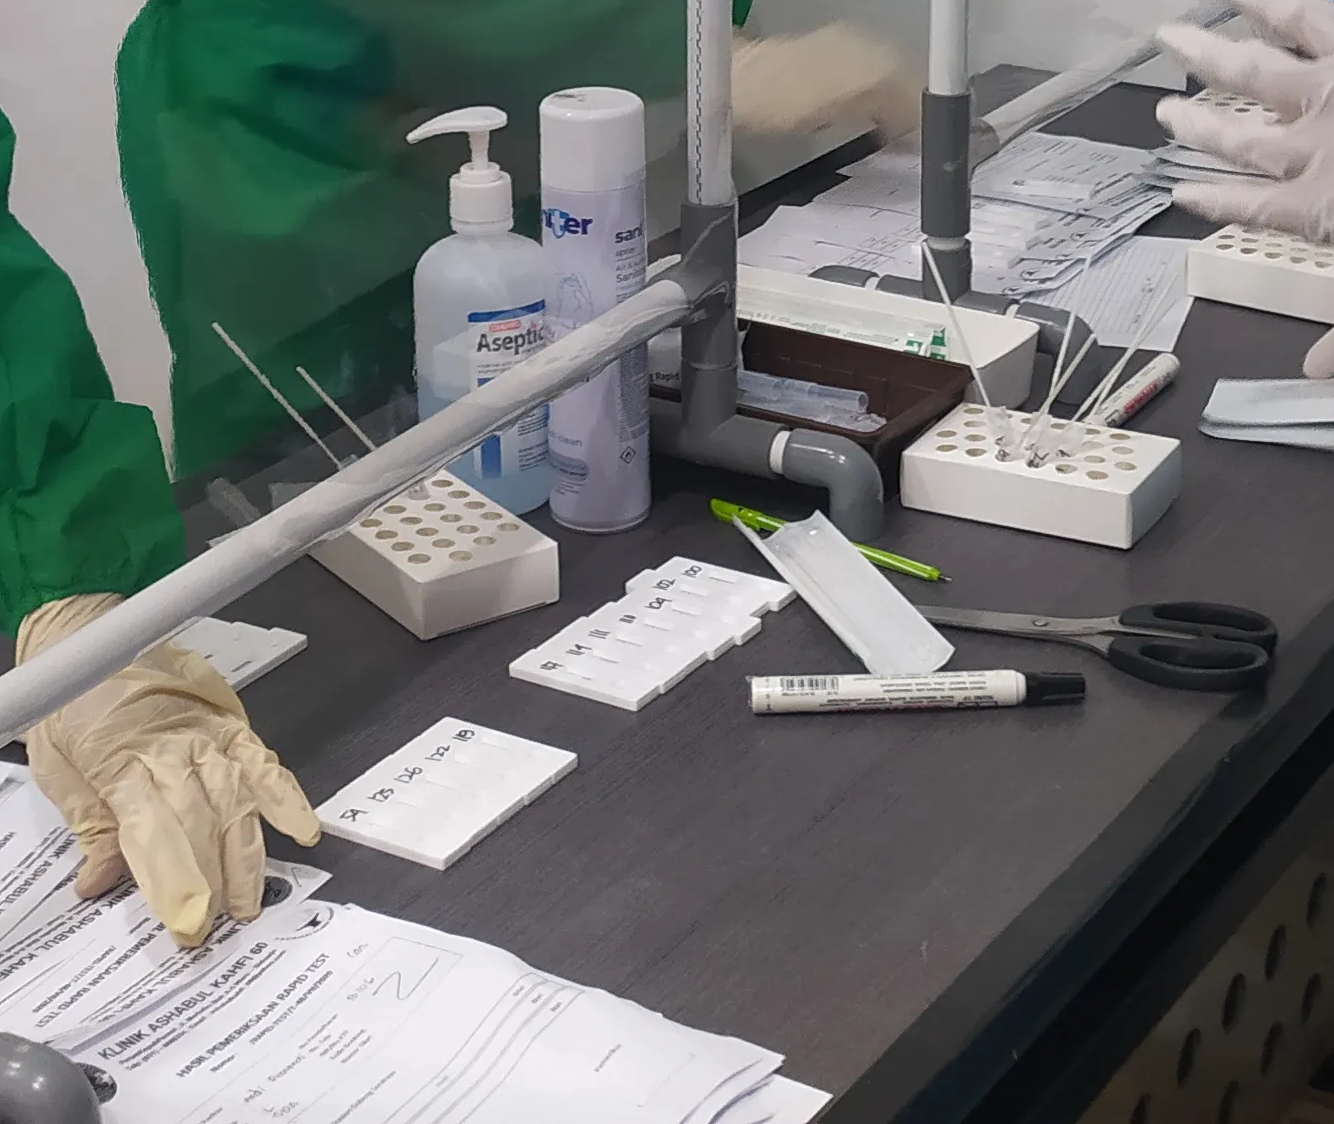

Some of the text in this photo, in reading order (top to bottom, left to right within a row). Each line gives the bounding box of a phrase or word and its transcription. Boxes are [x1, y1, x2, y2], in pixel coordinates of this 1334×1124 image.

[424, 744, 451, 762] 122
[393, 766, 423, 784] 126
[367, 787, 395, 803] 125
[49, 832, 80, 860] LINIK
[100, 881, 140, 912] LINIK
[36, 905, 99, 955] ASHABUL
[96, 1028, 149, 1061] KLINIK
[150, 983, 215, 1034] ASHABUL
[210, 951, 254, 991] KAHFI
[248, 938, 270, 959] 60
[207, 999, 280, 1057] PEMERIKSAAN
[275, 971, 309, 1003] RAPID
[304, 951, 331, 976] TEST
